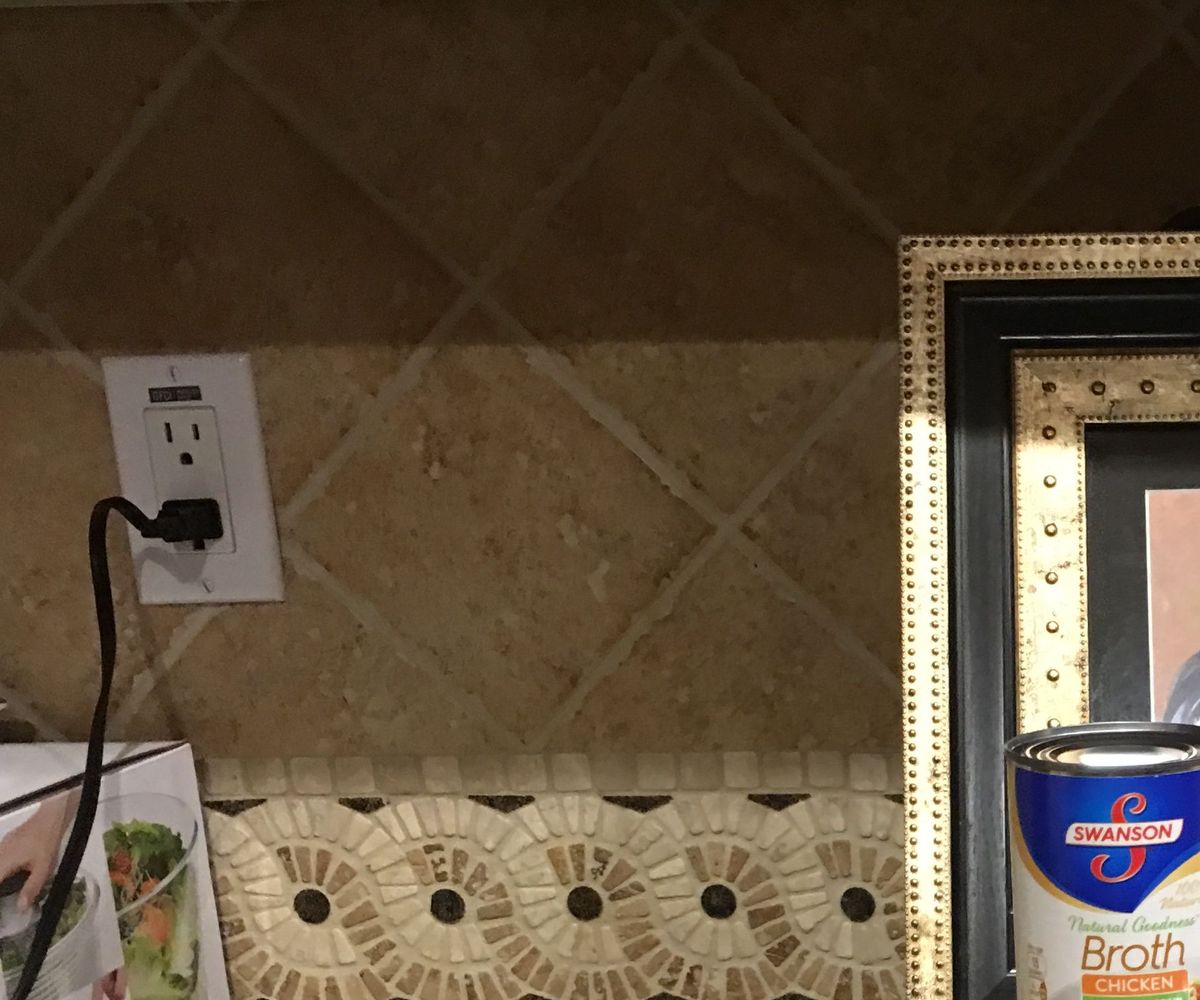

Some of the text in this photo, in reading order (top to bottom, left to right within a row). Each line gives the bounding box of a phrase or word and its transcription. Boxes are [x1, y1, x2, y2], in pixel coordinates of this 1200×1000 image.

[1073, 823, 1173, 842] SWANSON
[1067, 914, 1195, 933] Natural Goodness
[1081, 932, 1186, 971] Broth
[1095, 976, 1173, 992] CHICKEN
